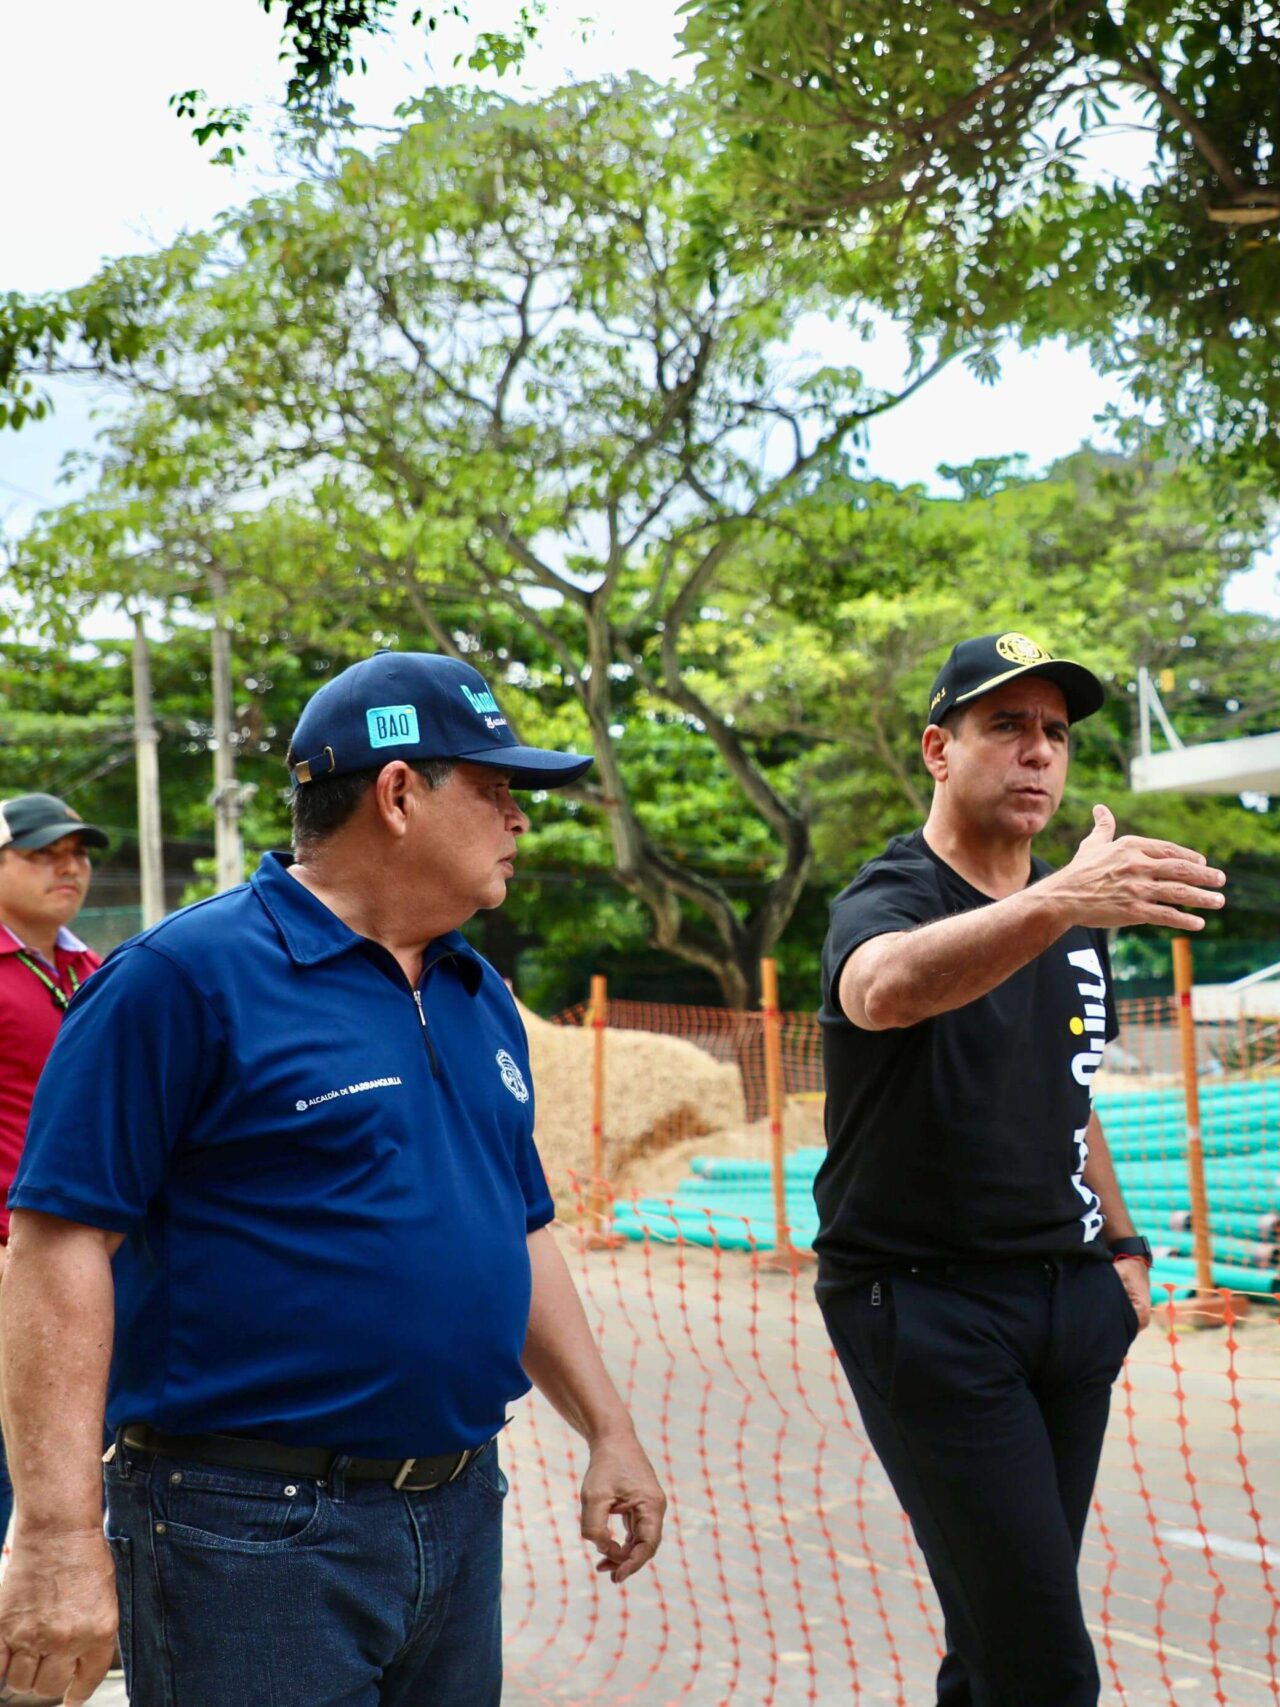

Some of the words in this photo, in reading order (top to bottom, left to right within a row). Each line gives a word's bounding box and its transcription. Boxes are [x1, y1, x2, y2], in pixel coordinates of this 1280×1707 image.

[376, 713, 409, 740] BAQ
[309, 1091, 339, 1105] ALCALDÍA
[349, 1077, 401, 1093] BARRANQUILLA
